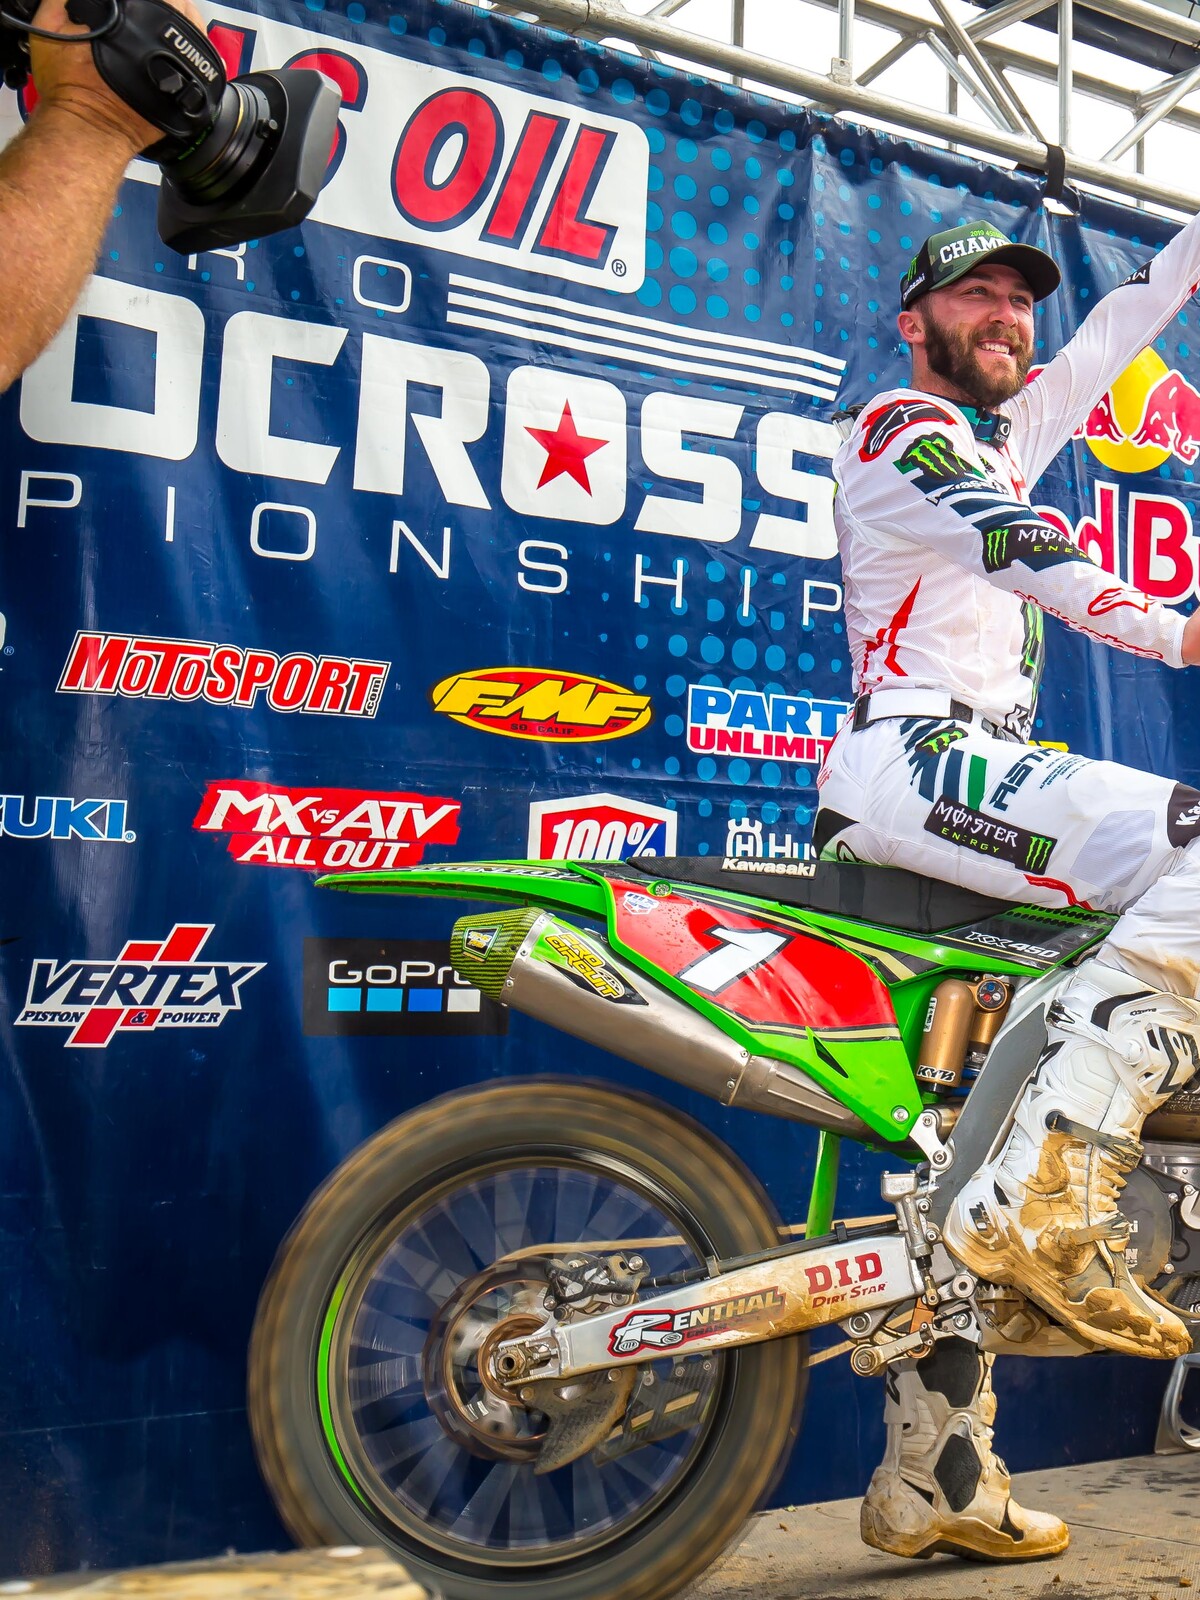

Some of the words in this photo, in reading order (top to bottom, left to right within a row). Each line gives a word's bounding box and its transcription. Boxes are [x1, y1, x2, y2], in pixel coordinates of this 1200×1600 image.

[164, 26, 219, 82] FUJINON
[390, 86, 619, 270] OIL
[433, 677, 651, 727] FMF
[690, 687, 856, 739] PART
[0, 795, 127, 842] UKI
[200, 789, 323, 836] MX
[318, 799, 461, 840] ATV
[235, 835, 318, 866] ALL
[322, 839, 410, 869] OUT
[552, 818, 659, 861] 100%
[721, 858, 817, 877] Kawasaki
[544, 935, 621, 998] CIRCUIT
[559, 932, 605, 968] PRO
[680, 925, 792, 994] 1
[29, 962, 258, 1007] VERTEX
[20, 1010, 85, 1023] PISTON
[129, 1011, 149, 1025] &
[158, 1012, 222, 1024] POWER
